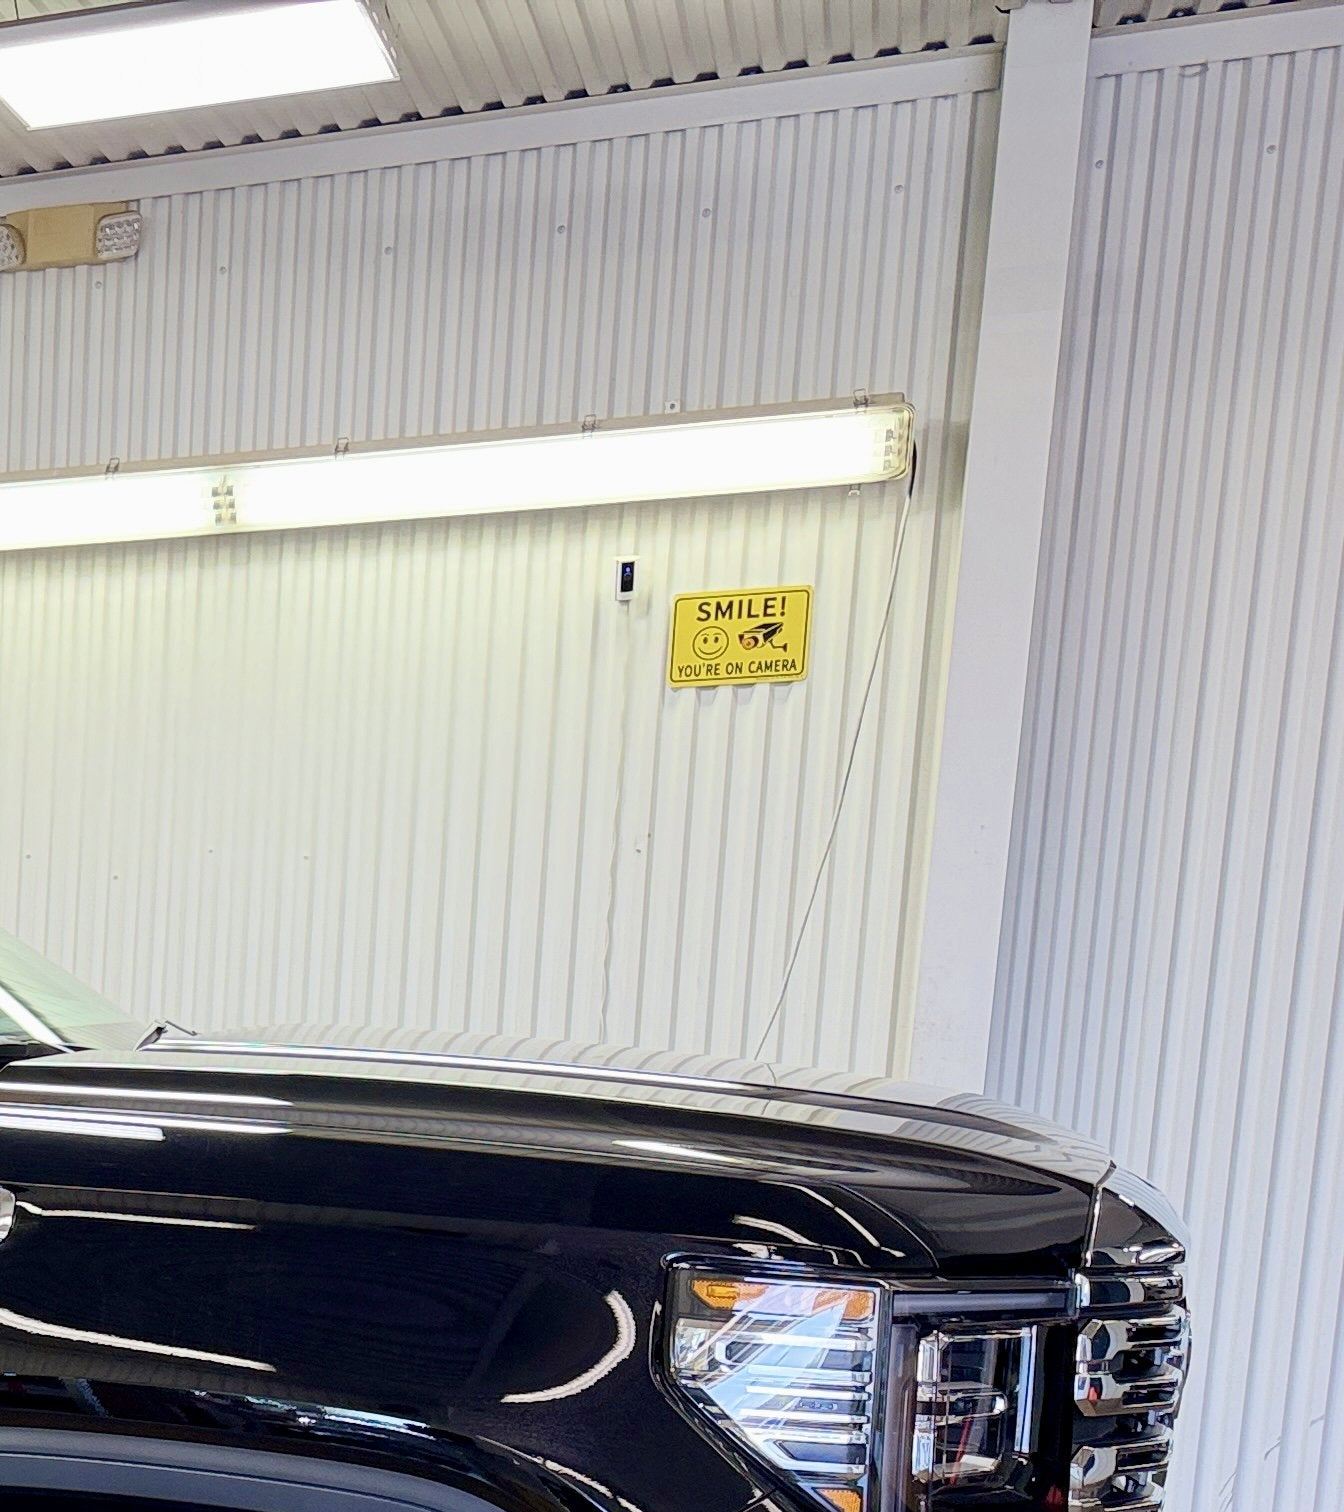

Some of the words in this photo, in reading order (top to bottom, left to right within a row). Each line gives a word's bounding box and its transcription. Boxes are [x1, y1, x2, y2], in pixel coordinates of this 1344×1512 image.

[696, 596, 787, 622] SMILE!
[677, 662, 721, 678] YOU'RE
[725, 661, 743, 676] ON
[748, 658, 798, 674] CAMERA
